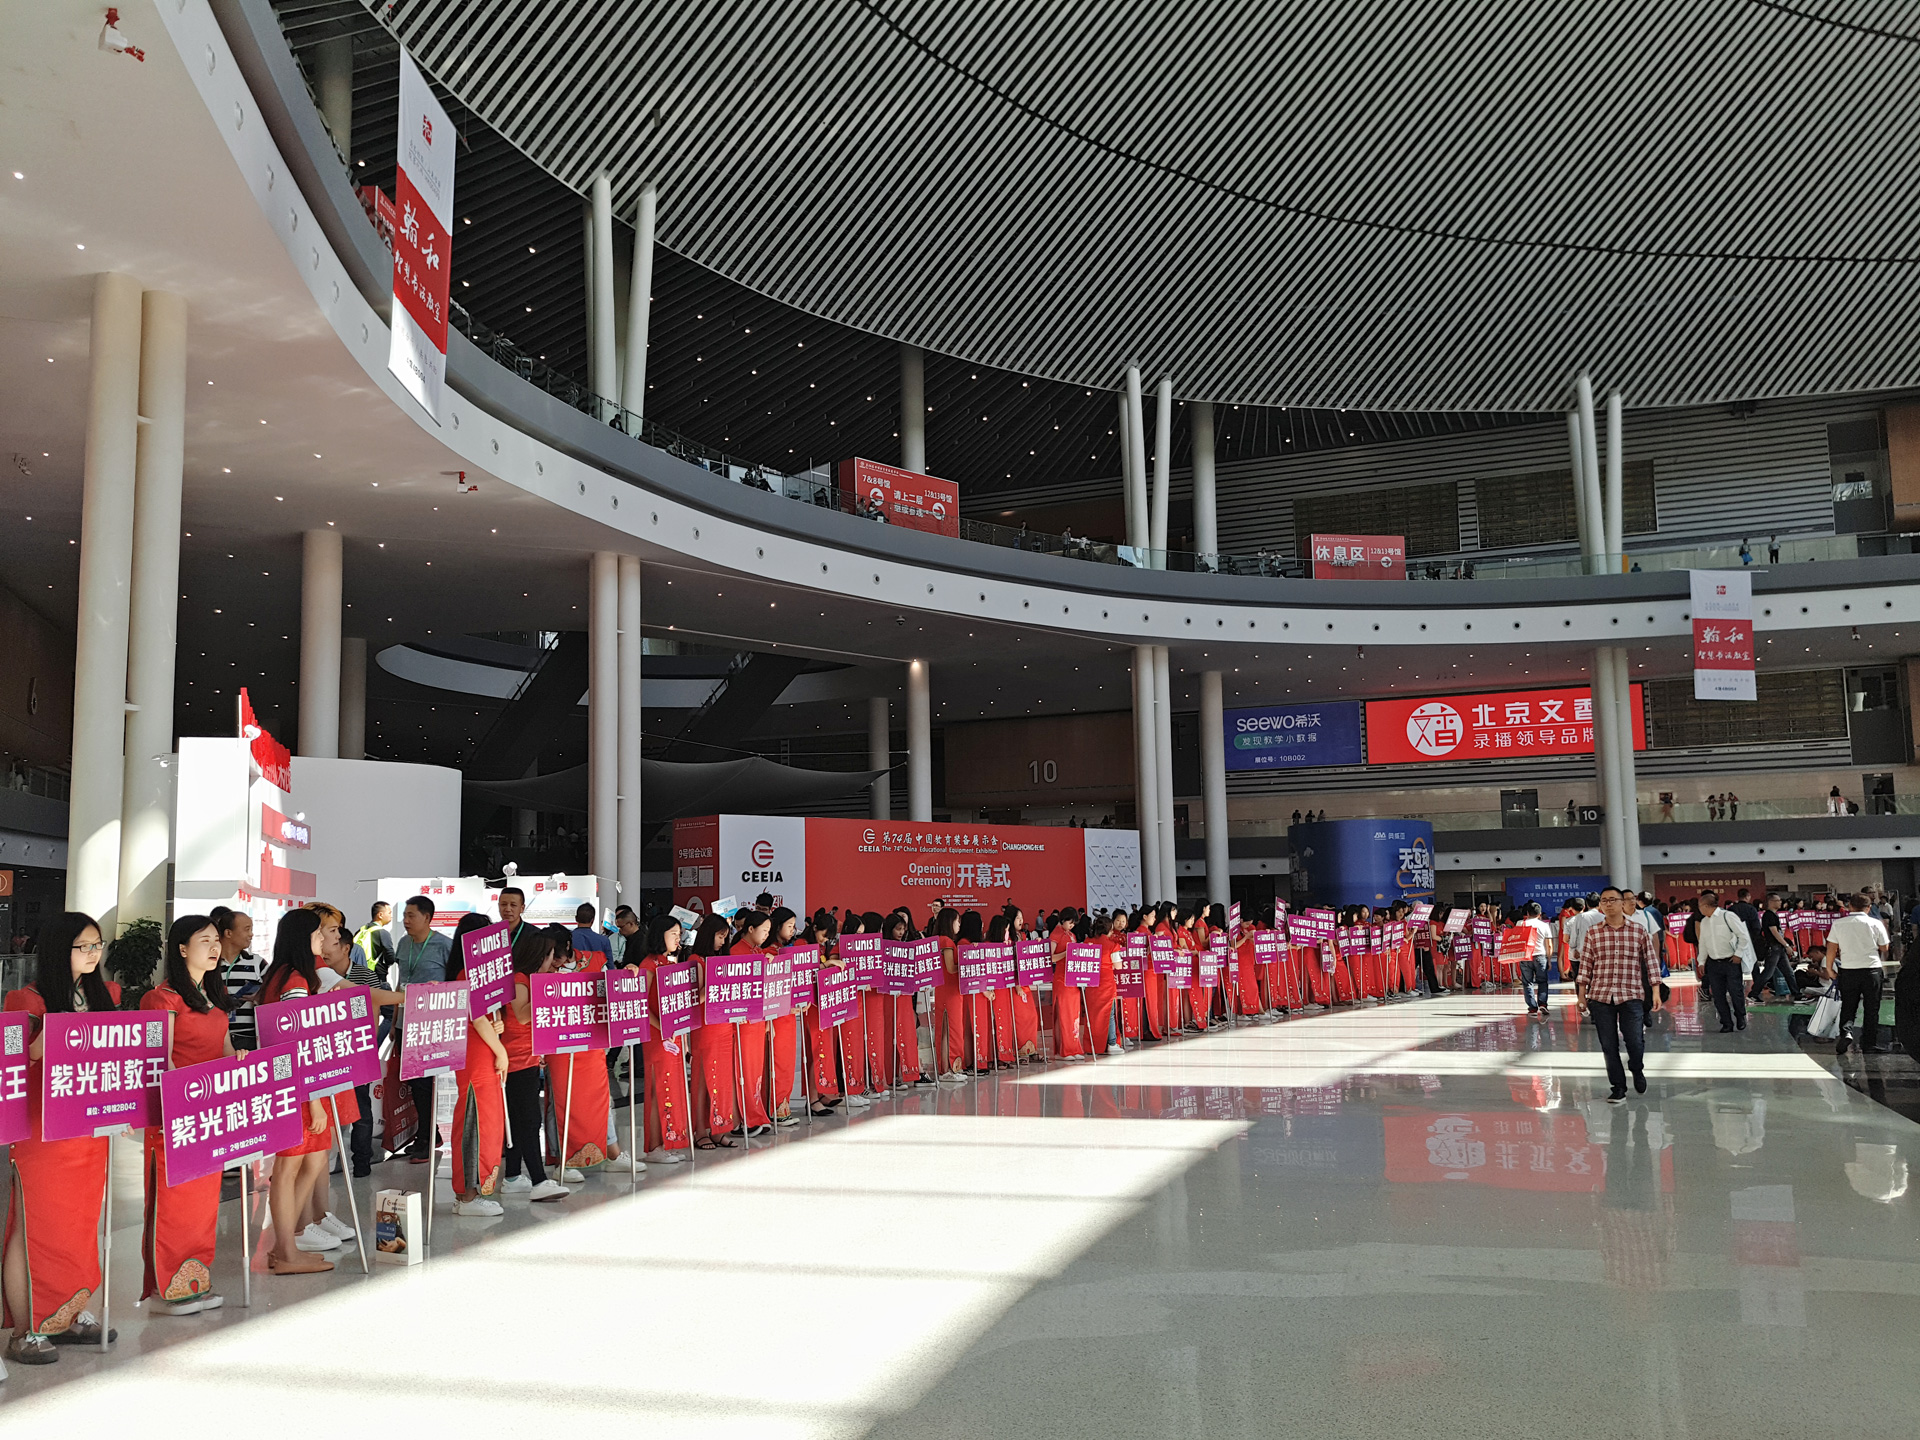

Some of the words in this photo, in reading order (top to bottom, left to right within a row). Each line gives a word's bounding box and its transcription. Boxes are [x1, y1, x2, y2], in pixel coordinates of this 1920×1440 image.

[1315, 545, 1365, 562] 休息区
[1472, 697, 1593, 727] 北京文香
[1242, 733, 1317, 746] 发现教学小数据
[1029, 760, 1057, 784] 10
[1582, 810, 1597, 821] 10
[678, 846, 713, 859] 9号馆会议室
[741, 871, 784, 883] CEEIA
[908, 862, 952, 877] Opening
[957, 863, 1011, 888] 开幕式
[535, 882, 568, 892] 巴市
[901, 875, 952, 889] Ceremony
[468, 953, 513, 992] 紫光科教王
[842, 954, 883, 971] 科教王
[791, 967, 819, 987] 光科教王
[661, 988, 699, 1015] 紫光科教王
[708, 981, 763, 1003] 紫光科教王
[820, 984, 857, 1010] 紫光科教王
[536, 1004, 609, 1029] 紫光科教王
[610, 999, 649, 1022] 紫光科教王
[406, 1016, 467, 1048] 紫光科教王
[297, 1025, 375, 1068] 光科教王
[50, 1057, 165, 1098] 紫光科教王
[171, 1086, 297, 1149] 紫光科教王
